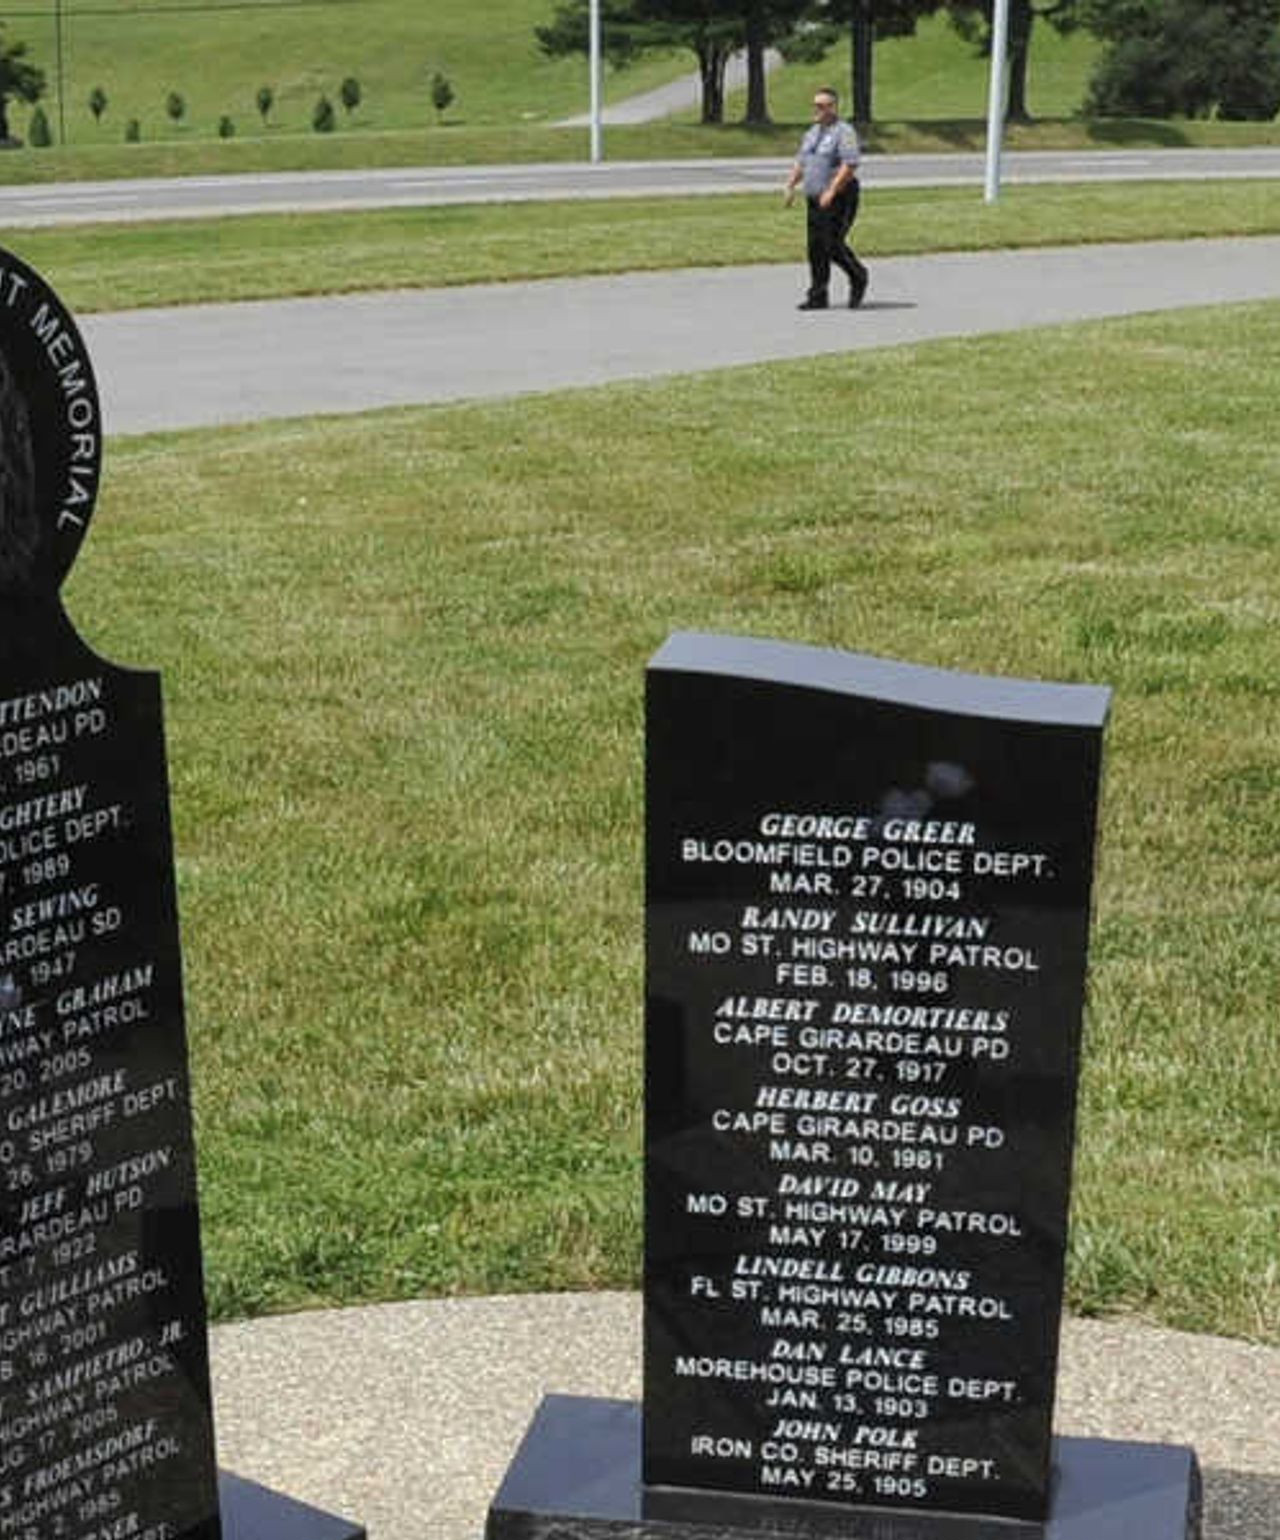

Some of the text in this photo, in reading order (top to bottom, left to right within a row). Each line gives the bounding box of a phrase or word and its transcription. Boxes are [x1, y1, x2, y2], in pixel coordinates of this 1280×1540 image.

[29, 303, 96, 533] MEMORIAL
[761, 814, 975, 844] GEORGE GREER
[683, 839, 852, 867] BLOOMFIELD
[862, 847, 961, 873] POLICE
[903, 878, 960, 900] 1904
[742, 907, 987, 938] RANDY SULLIVAN
[689, 932, 731, 953] MO
[792, 937, 917, 963] HIGHWAY
[930, 944, 1039, 970] PATROL
[891, 971, 948, 993] 1996
[716, 997, 1008, 1031] ALBERT DEMORTIERS
[714, 1022, 1009, 1059] CAPE GIRARDEAU PD
[897, 1060, 946, 1082] 1917
[756, 1087, 960, 1118] HERBERT GOSS
[713, 1110, 1003, 1148] CAPE GIRARDEAU PD
[778, 1174, 931, 1203] DAVID MAY
[688, 1194, 727, 1215] MO
[786, 1201, 906, 1226] HIGHWAY
[917, 1209, 1021, 1236] PATROL
[770, 1225, 826, 1246] MAY
[882, 1233, 936, 1254] 1999
[736, 1255, 970, 1290] LINDELL GIBBONS
[691, 1276, 719, 1297] FL
[779, 1284, 897, 1309] HIGHWAY
[909, 1292, 1011, 1319] PATROL
[886, 1317, 938, 1338] 1985
[771, 1339, 925, 1369] DAN LANCE
[676, 1357, 835, 1386] MOREHOUSE
[846, 1369, 938, 1395] POLICE
[875, 1397, 927, 1418] 1903
[773, 1420, 918, 1449] JOHN POLK
[692, 1436, 751, 1458] IRON
[815, 1446, 917, 1470] SHERIFF
[762, 1466, 815, 1486] MAY
[874, 1475, 926, 1497] 1905
